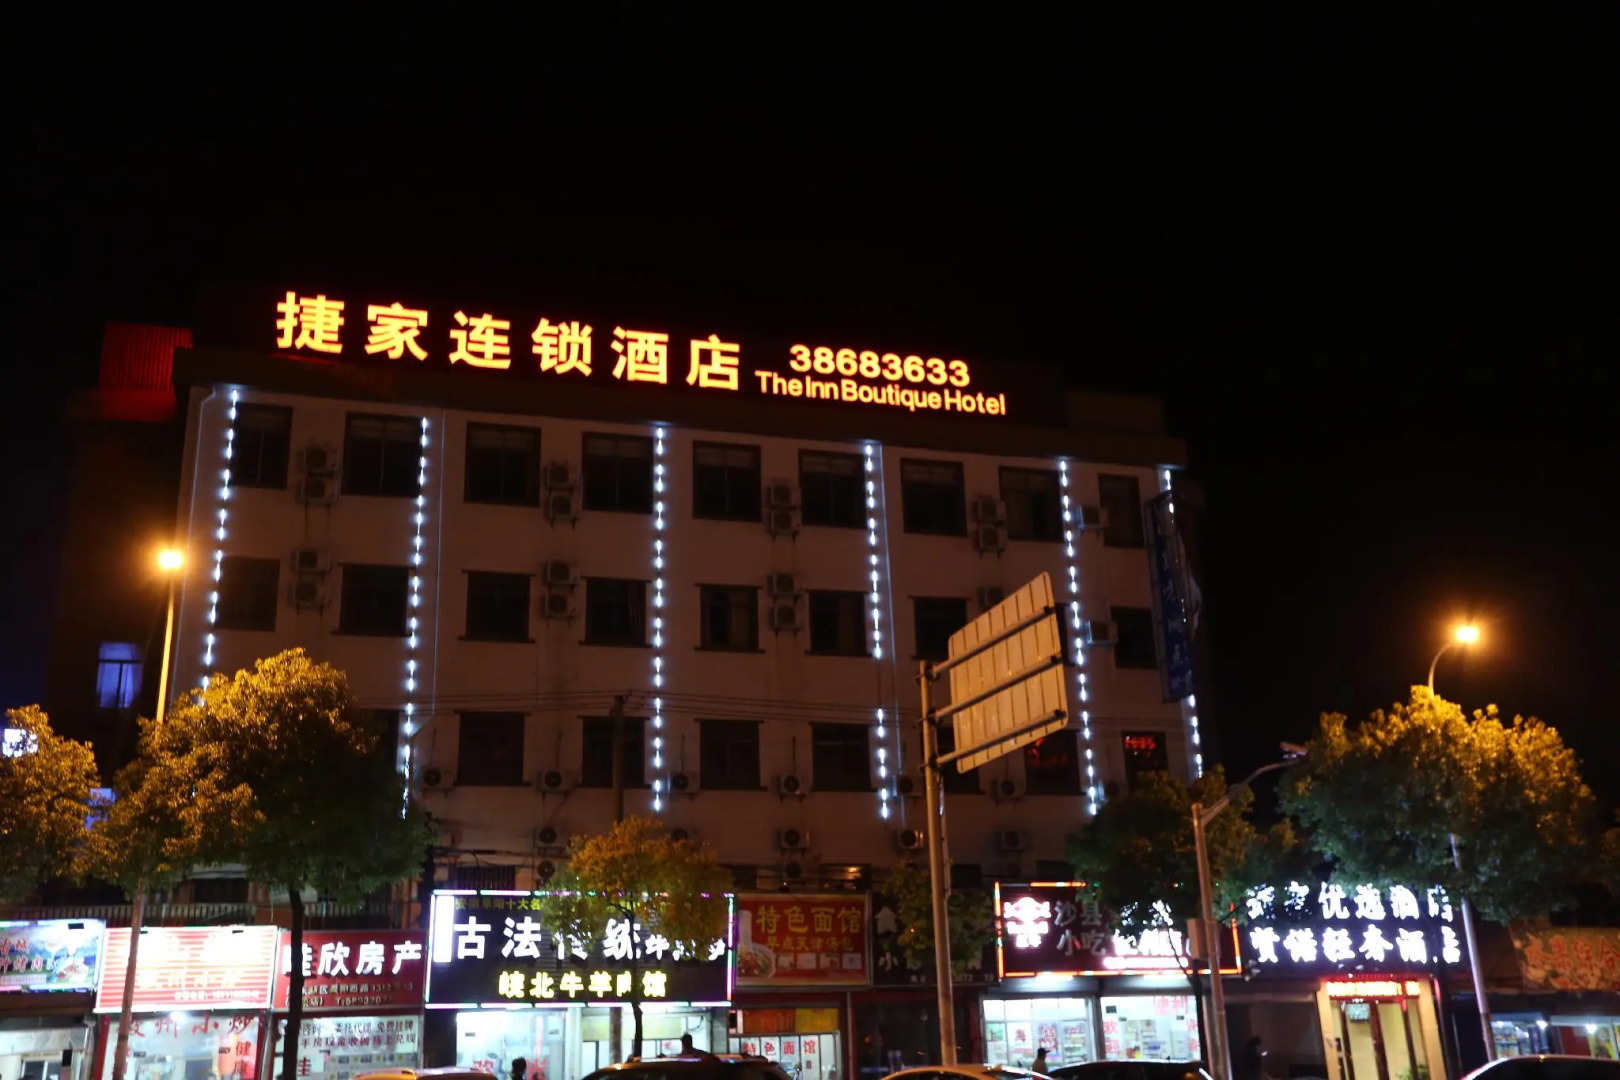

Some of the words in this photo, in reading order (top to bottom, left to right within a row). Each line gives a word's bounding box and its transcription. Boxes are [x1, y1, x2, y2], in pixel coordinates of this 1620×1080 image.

[276, 290, 741, 392] 捷家连锁酒店
[789, 344, 970, 388] 38683633
[754, 370, 803, 396] The
[805, 375, 839, 400] Inn
[841, 378, 942, 412] Boutique
[943, 388, 1007, 415] Hotel
[756, 905, 861, 934] 特色面馆
[1245, 880, 1454, 922] 优选酒
[1055, 929, 1106, 956] 小吃
